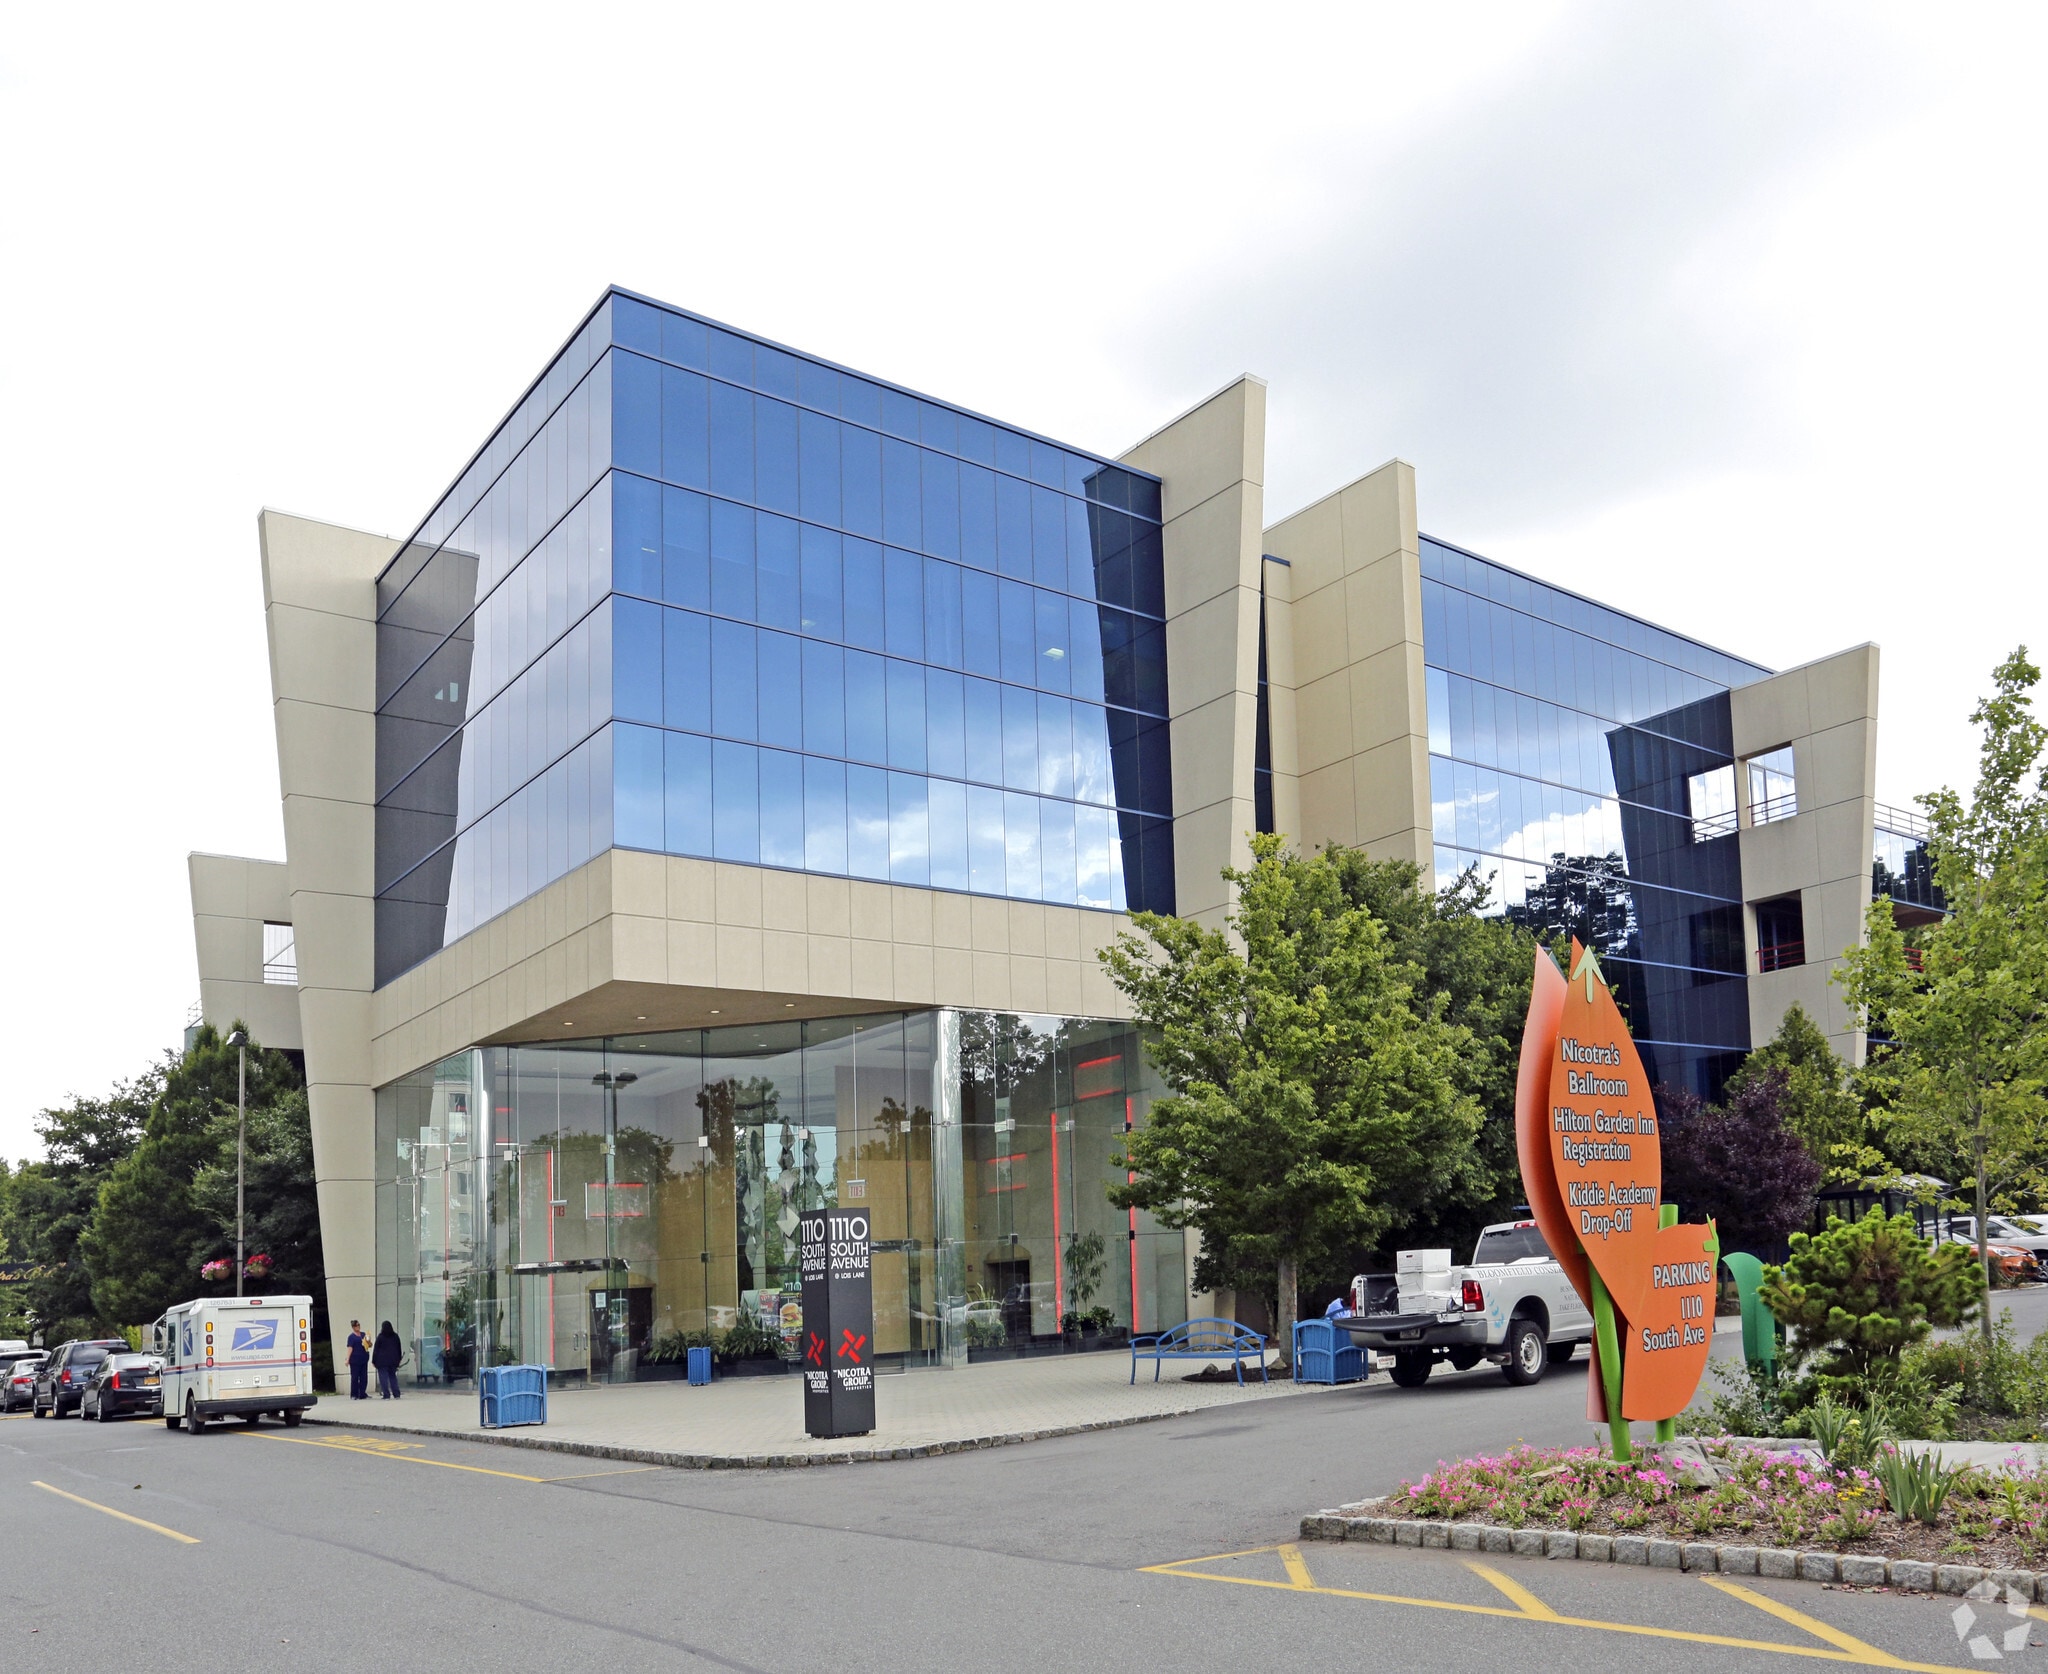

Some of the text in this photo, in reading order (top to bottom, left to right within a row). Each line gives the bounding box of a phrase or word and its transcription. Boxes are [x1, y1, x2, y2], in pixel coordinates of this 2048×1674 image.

[1561, 1038, 1620, 1066] Nicotra's
[1568, 1071, 1628, 1096] Ballroom
[1554, 1107, 1655, 1135] Hilton Garden Inn
[1562, 1136, 1631, 1167] Registration
[1568, 1181, 1657, 1210] Kiddie Academy
[801, 1218, 825, 1243] 1110
[829, 1216, 868, 1240] 1110
[1581, 1208, 1632, 1240] Drop-Off
[801, 1243, 826, 1259] SOUTH
[830, 1242, 869, 1257] SOUTH
[802, 1257, 826, 1272] AVENUE
[830, 1256, 869, 1270] AVENUE
[852, 1271, 865, 1279] LANE
[1477, 1267, 1532, 1279] BLOOMFIELD
[1653, 1260, 1710, 1289] PARKING
[1681, 1295, 1704, 1320] 1110
[1642, 1322, 1705, 1352] South Ave
[807, 1371, 828, 1380] NICOTRA
[837, 1366, 872, 1379] NICOTRA
